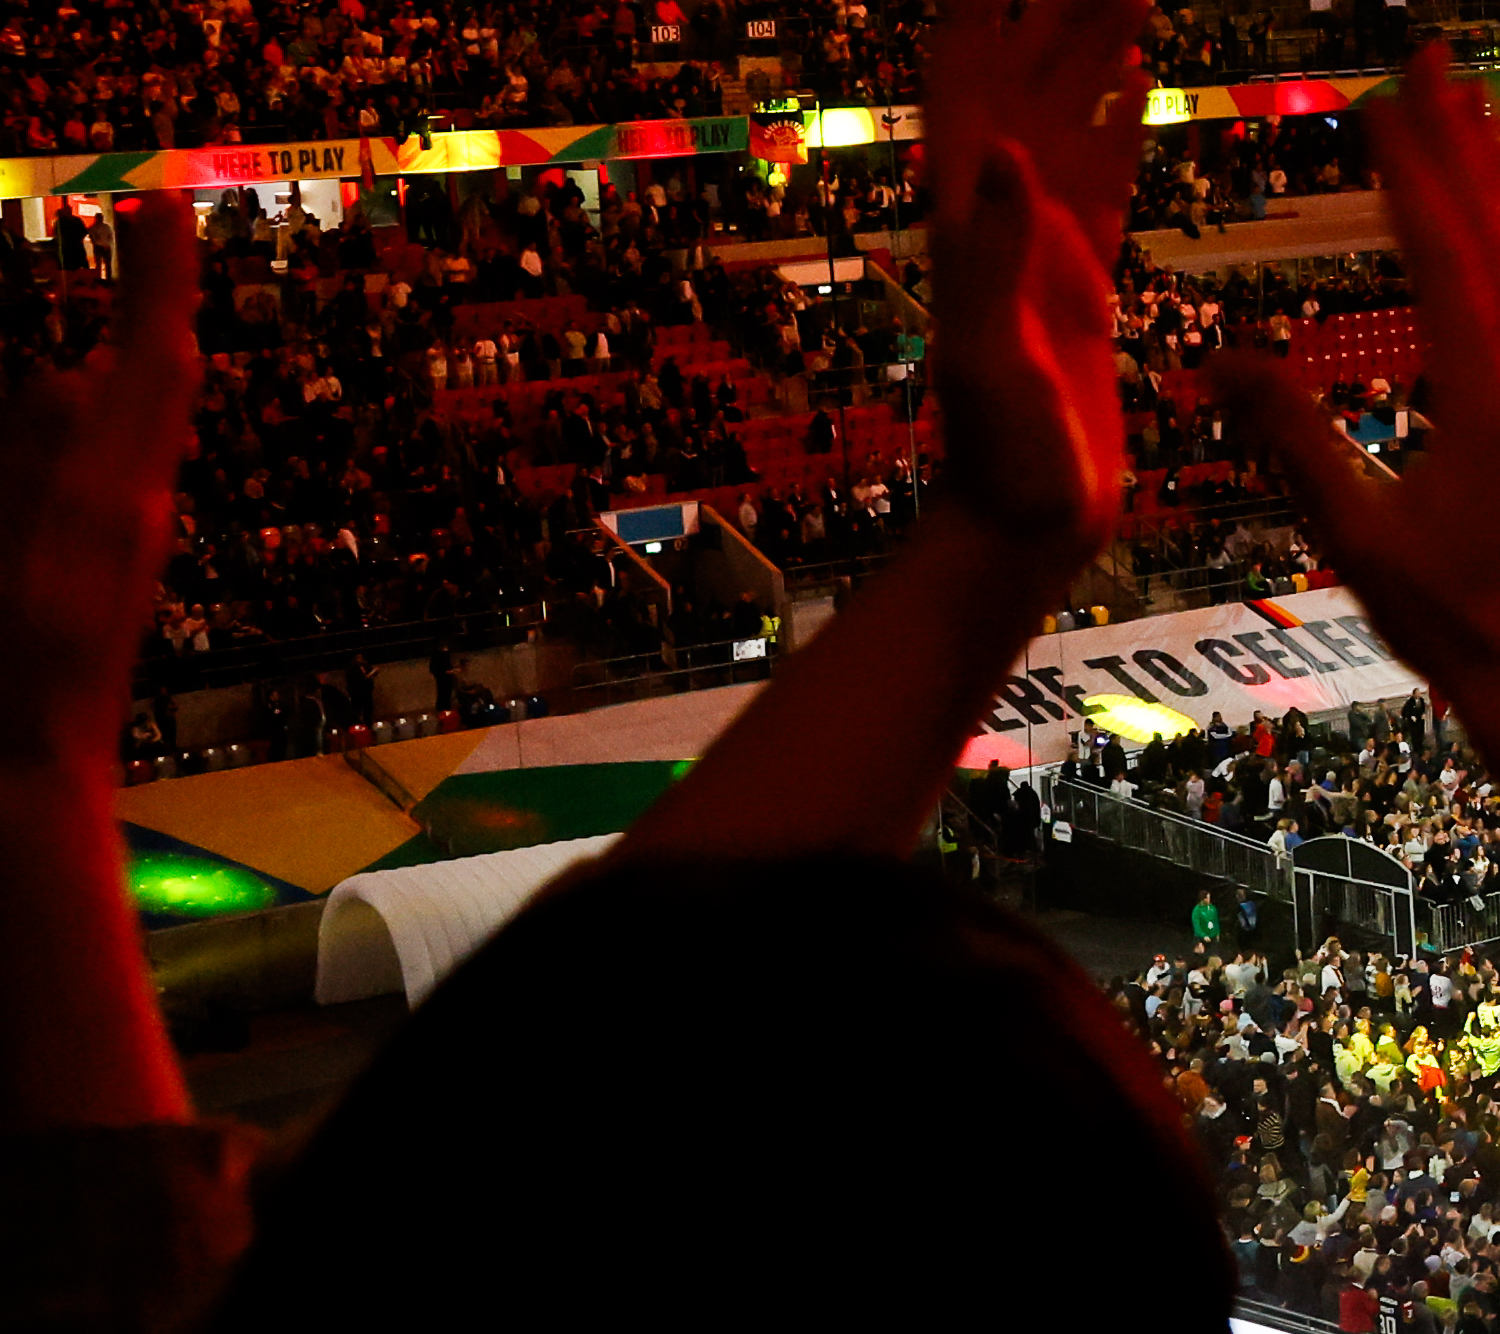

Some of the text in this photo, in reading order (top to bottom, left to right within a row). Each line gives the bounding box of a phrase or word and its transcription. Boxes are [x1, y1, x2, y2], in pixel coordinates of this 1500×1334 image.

[653, 25, 680, 41] 103
[749, 21, 775, 38] 104
[1166, 93, 1199, 115] PLAY
[690, 122, 731, 148] PLAY
[213, 147, 345, 178] HERE TO PLAY
[978, 614, 1400, 731] ERE TO CELEB
